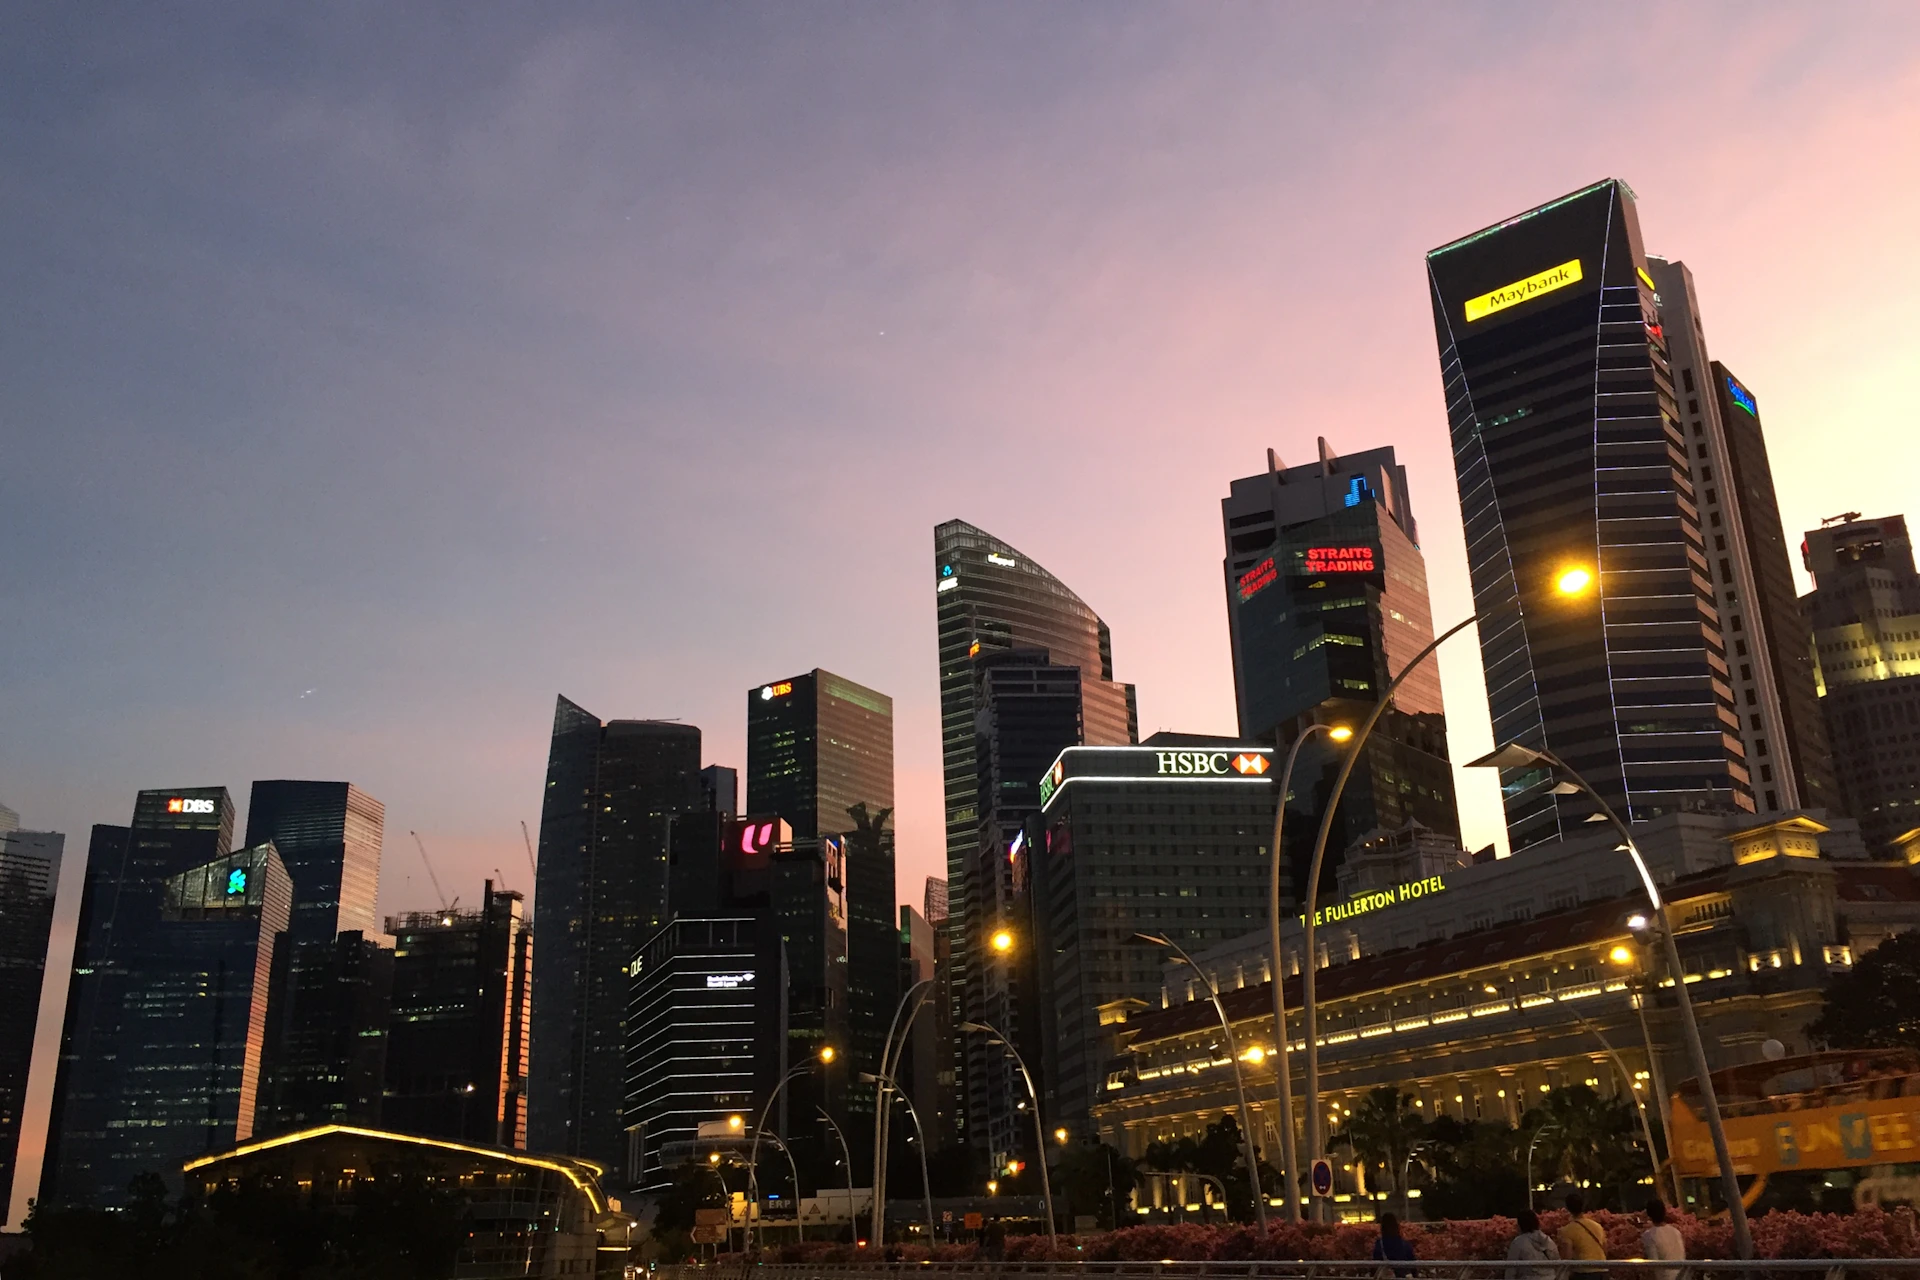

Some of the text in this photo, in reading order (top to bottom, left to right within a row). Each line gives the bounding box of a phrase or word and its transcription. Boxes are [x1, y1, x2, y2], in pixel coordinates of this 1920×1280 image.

[1489, 269, 1569, 307] Maybank
[1307, 547, 1373, 560] STRAITS
[1239, 556, 1275, 587] STRAITS
[1305, 560, 1375, 573] TRADING
[1241, 568, 1278, 599] TRADING
[773, 682, 792, 697] UBS
[1156, 752, 1229, 775] HSBC
[183, 799, 214, 814] DBS
[1325, 889, 1396, 923] FULLERTON
[1399, 875, 1446, 901] HOTEL
[768, 1200, 791, 1209] ERP
